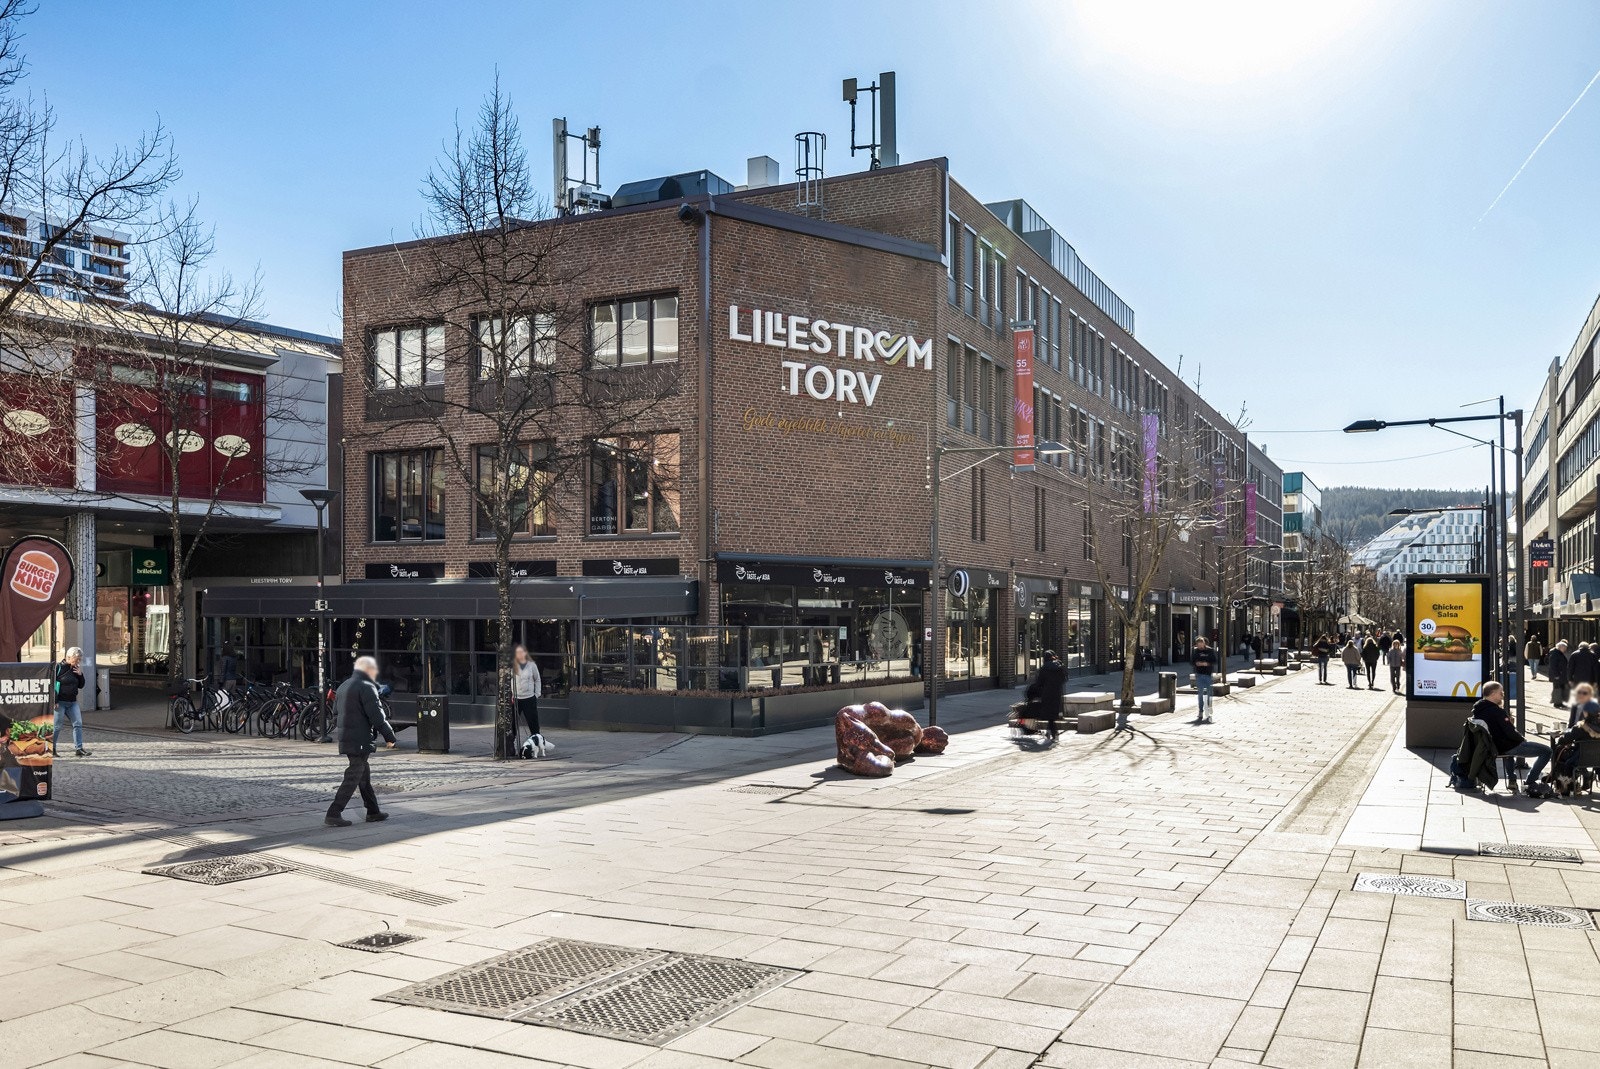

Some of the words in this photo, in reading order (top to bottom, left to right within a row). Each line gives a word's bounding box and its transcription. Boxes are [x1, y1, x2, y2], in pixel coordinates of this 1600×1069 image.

[1016, 359, 1027, 368] 55
[782, 361, 882, 407] TORV
[18, 561, 56, 581] BURGER
[14, 570, 53, 593] KING
[5, 694, 49, 704] CHICKEN
